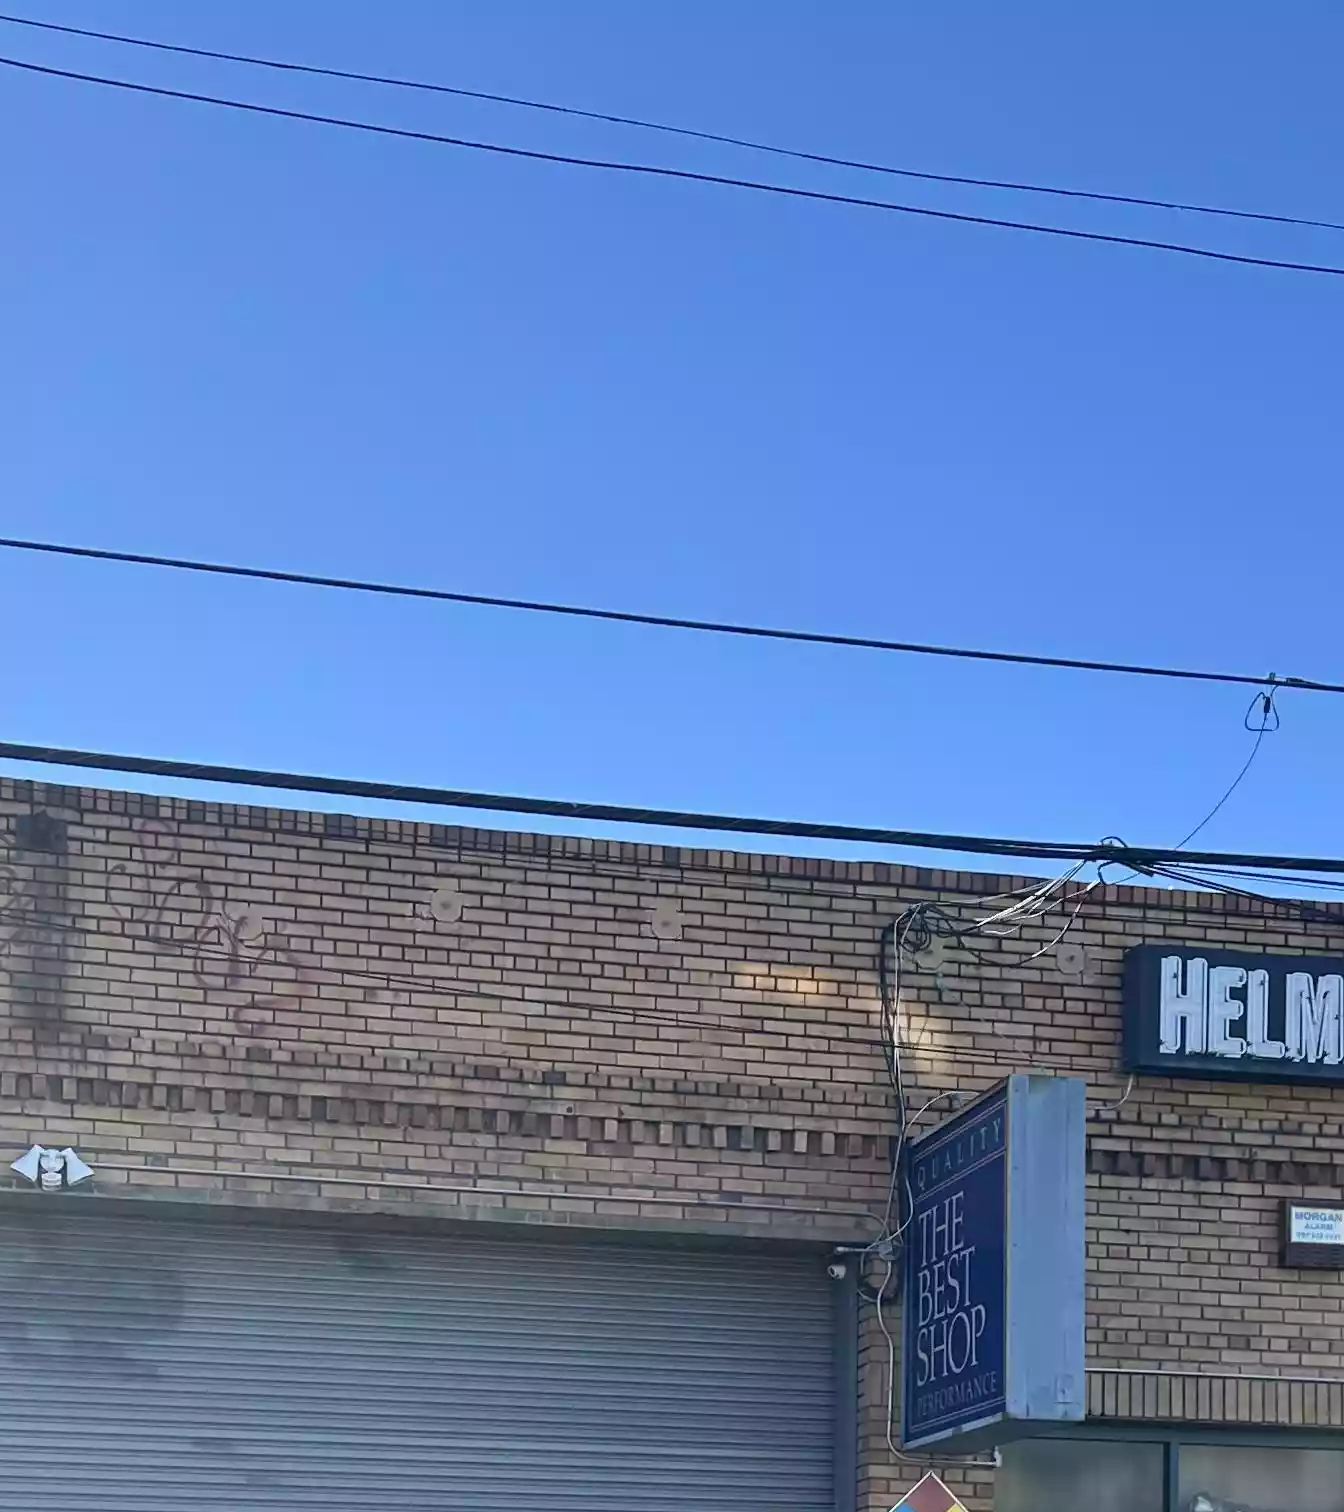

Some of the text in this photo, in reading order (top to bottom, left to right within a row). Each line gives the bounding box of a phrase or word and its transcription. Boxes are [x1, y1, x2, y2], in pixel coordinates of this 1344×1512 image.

[917, 1117, 1001, 1191] QUALITY
[918, 1190, 964, 1268] THE
[918, 1246, 975, 1328] BEST
[916, 1303, 986, 1387] SHOP
[917, 1370, 998, 1418] PERFORMANCE
